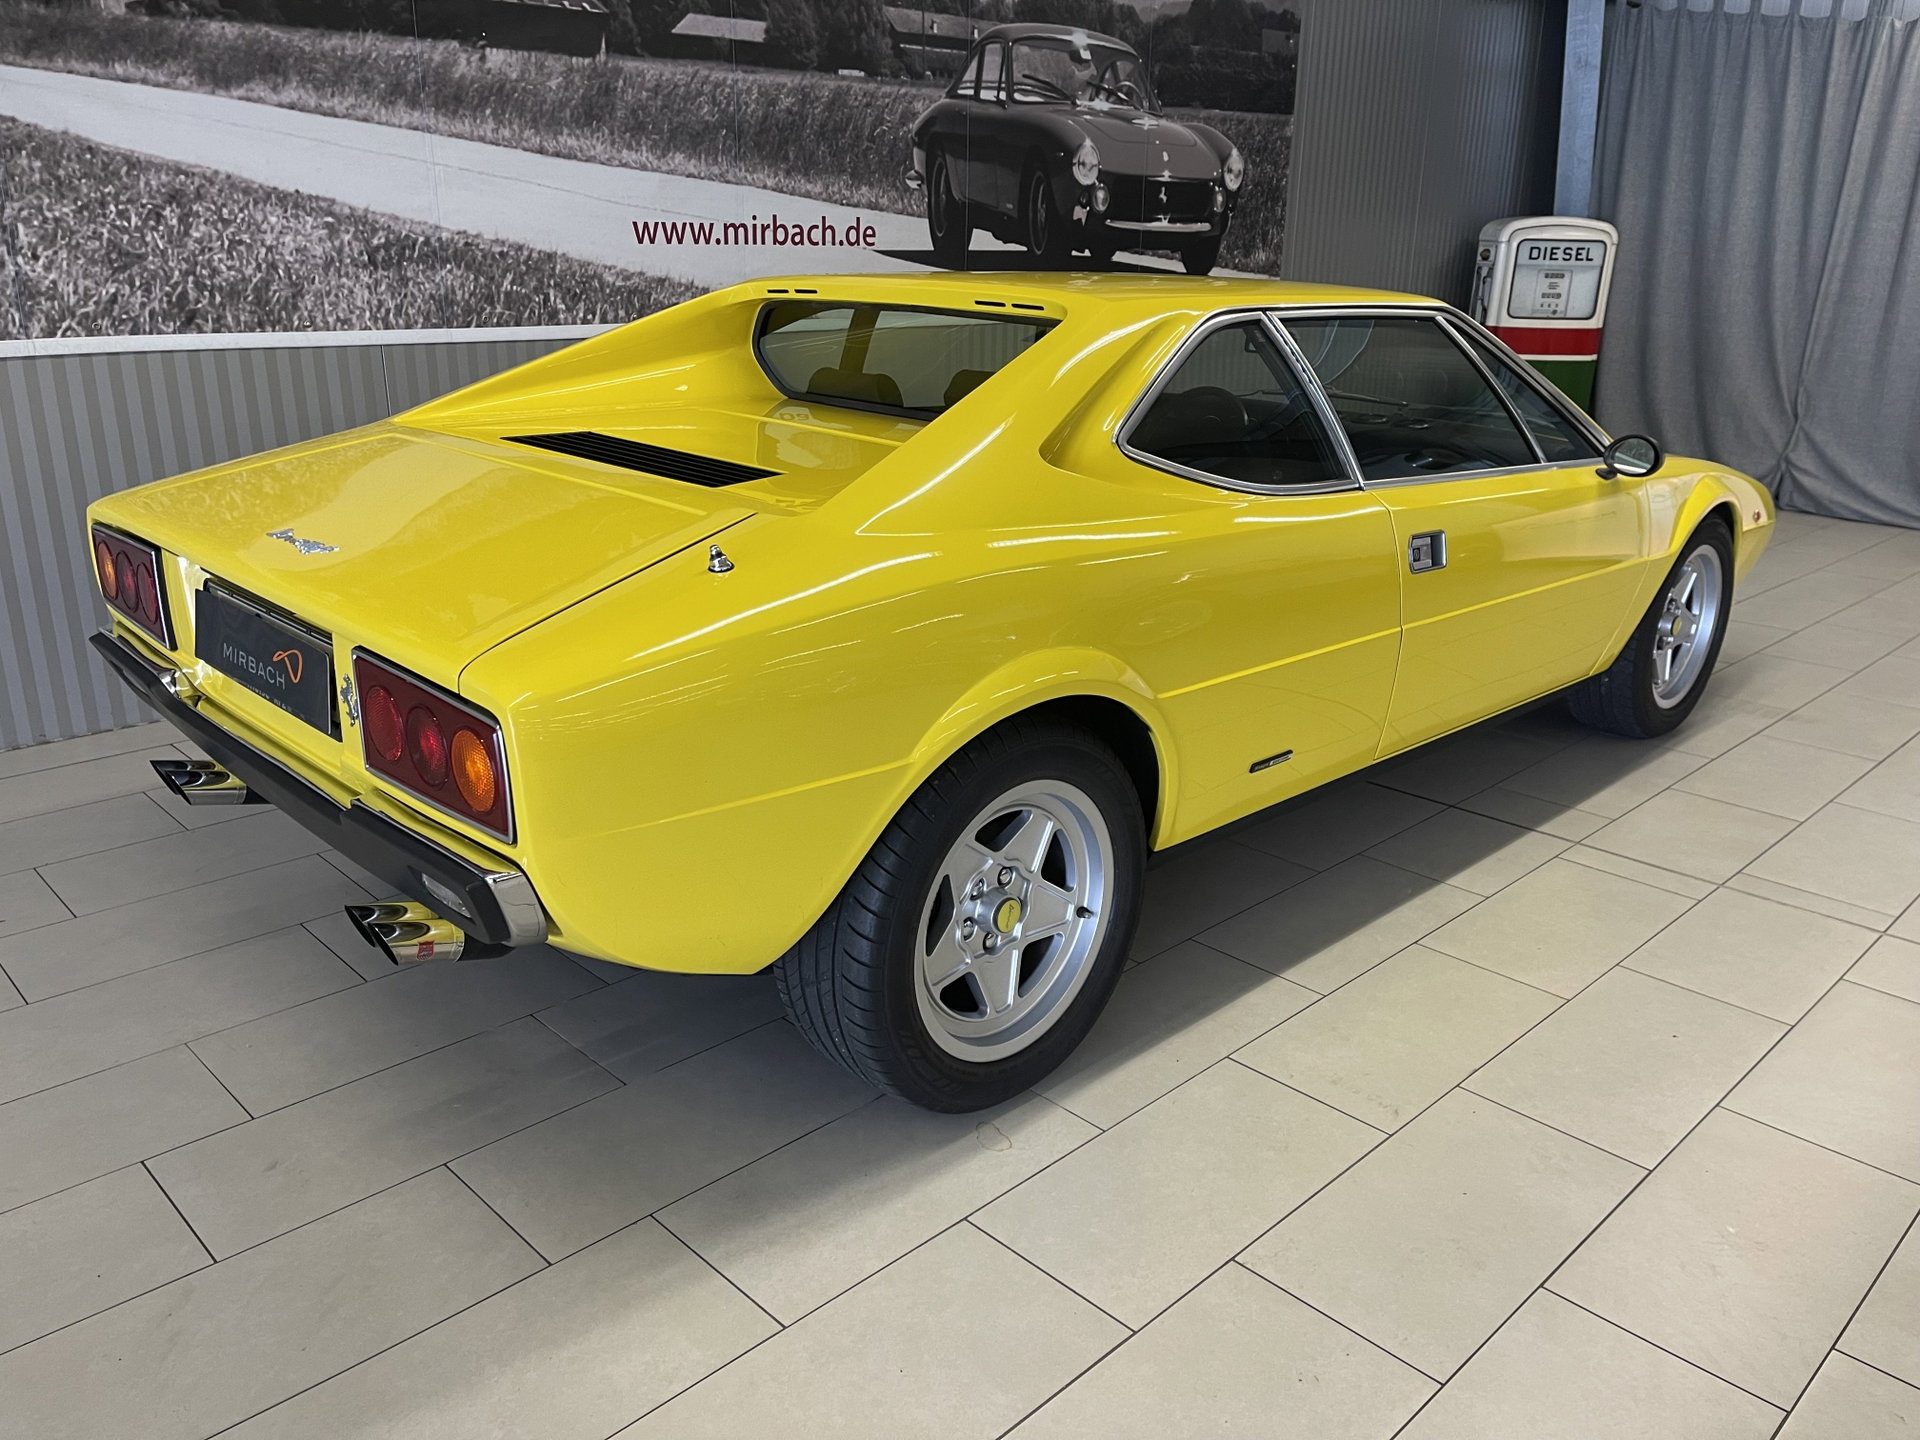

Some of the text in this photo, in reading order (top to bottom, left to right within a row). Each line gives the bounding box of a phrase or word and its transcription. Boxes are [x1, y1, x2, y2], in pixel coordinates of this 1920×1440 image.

[632, 214, 877, 247] www.mirbach.de
[1528, 246, 1594, 262] DIESEL
[223, 642, 285, 690] MIRBACH
